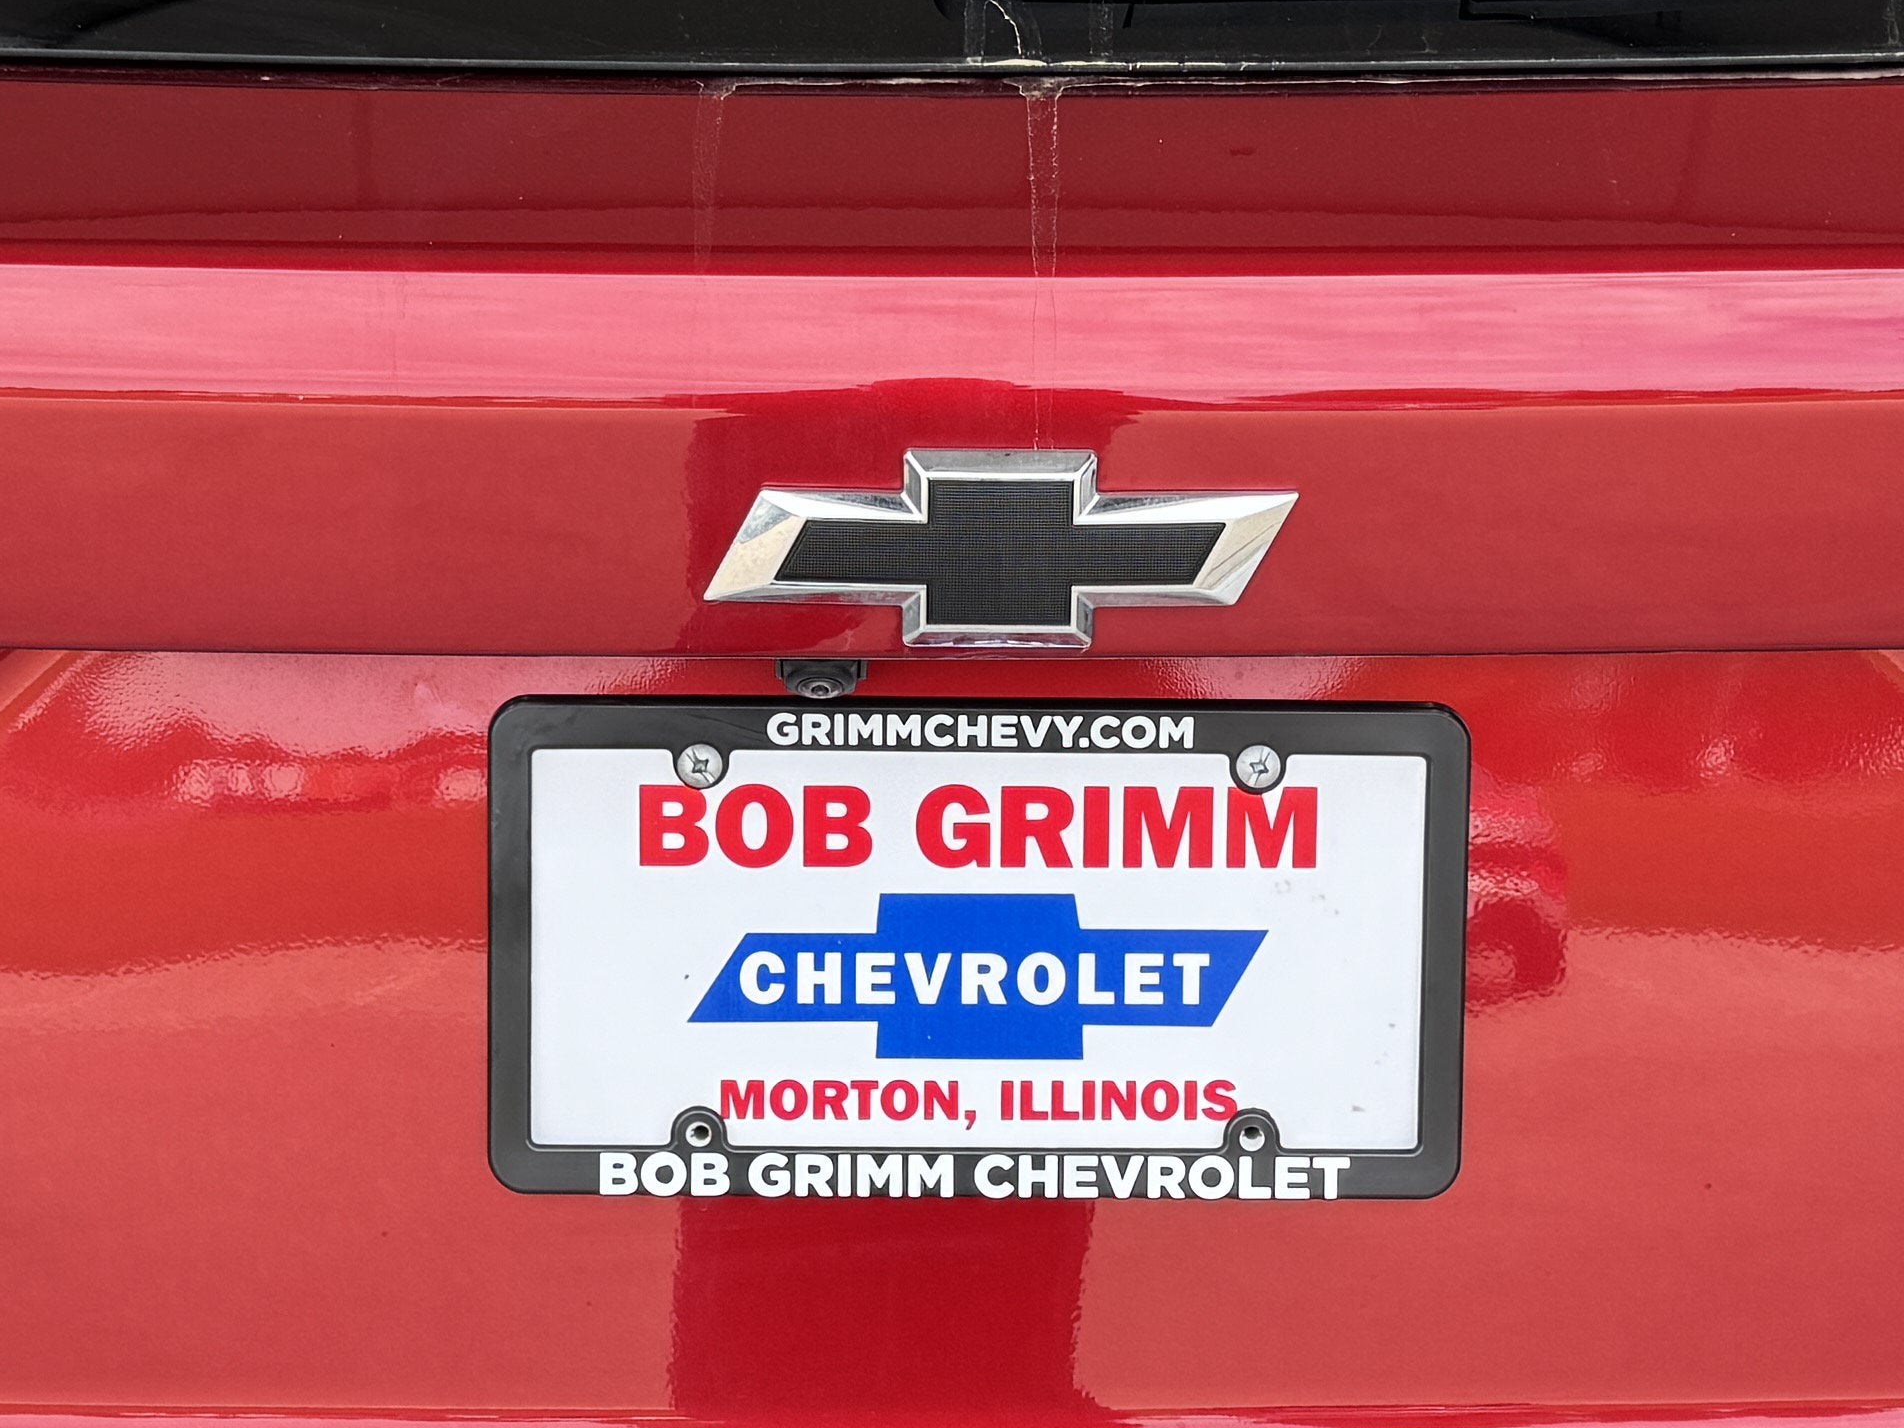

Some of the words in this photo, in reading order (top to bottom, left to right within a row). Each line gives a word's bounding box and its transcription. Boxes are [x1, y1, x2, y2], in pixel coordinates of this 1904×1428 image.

[766, 712, 1196, 749] GRIMMCHEVY.COM
[638, 782, 873, 869] BOB
[915, 783, 1319, 869] GRIMM
[737, 951, 1214, 1006] CHEVROLET
[719, 1079, 978, 1130] MORTON,
[999, 1079, 1240, 1122] ILLINOIS
[598, 1150, 732, 1198] BOB
[747, 1150, 956, 1199] GRIMM
[972, 1152, 1352, 1201] CHEVROLET
